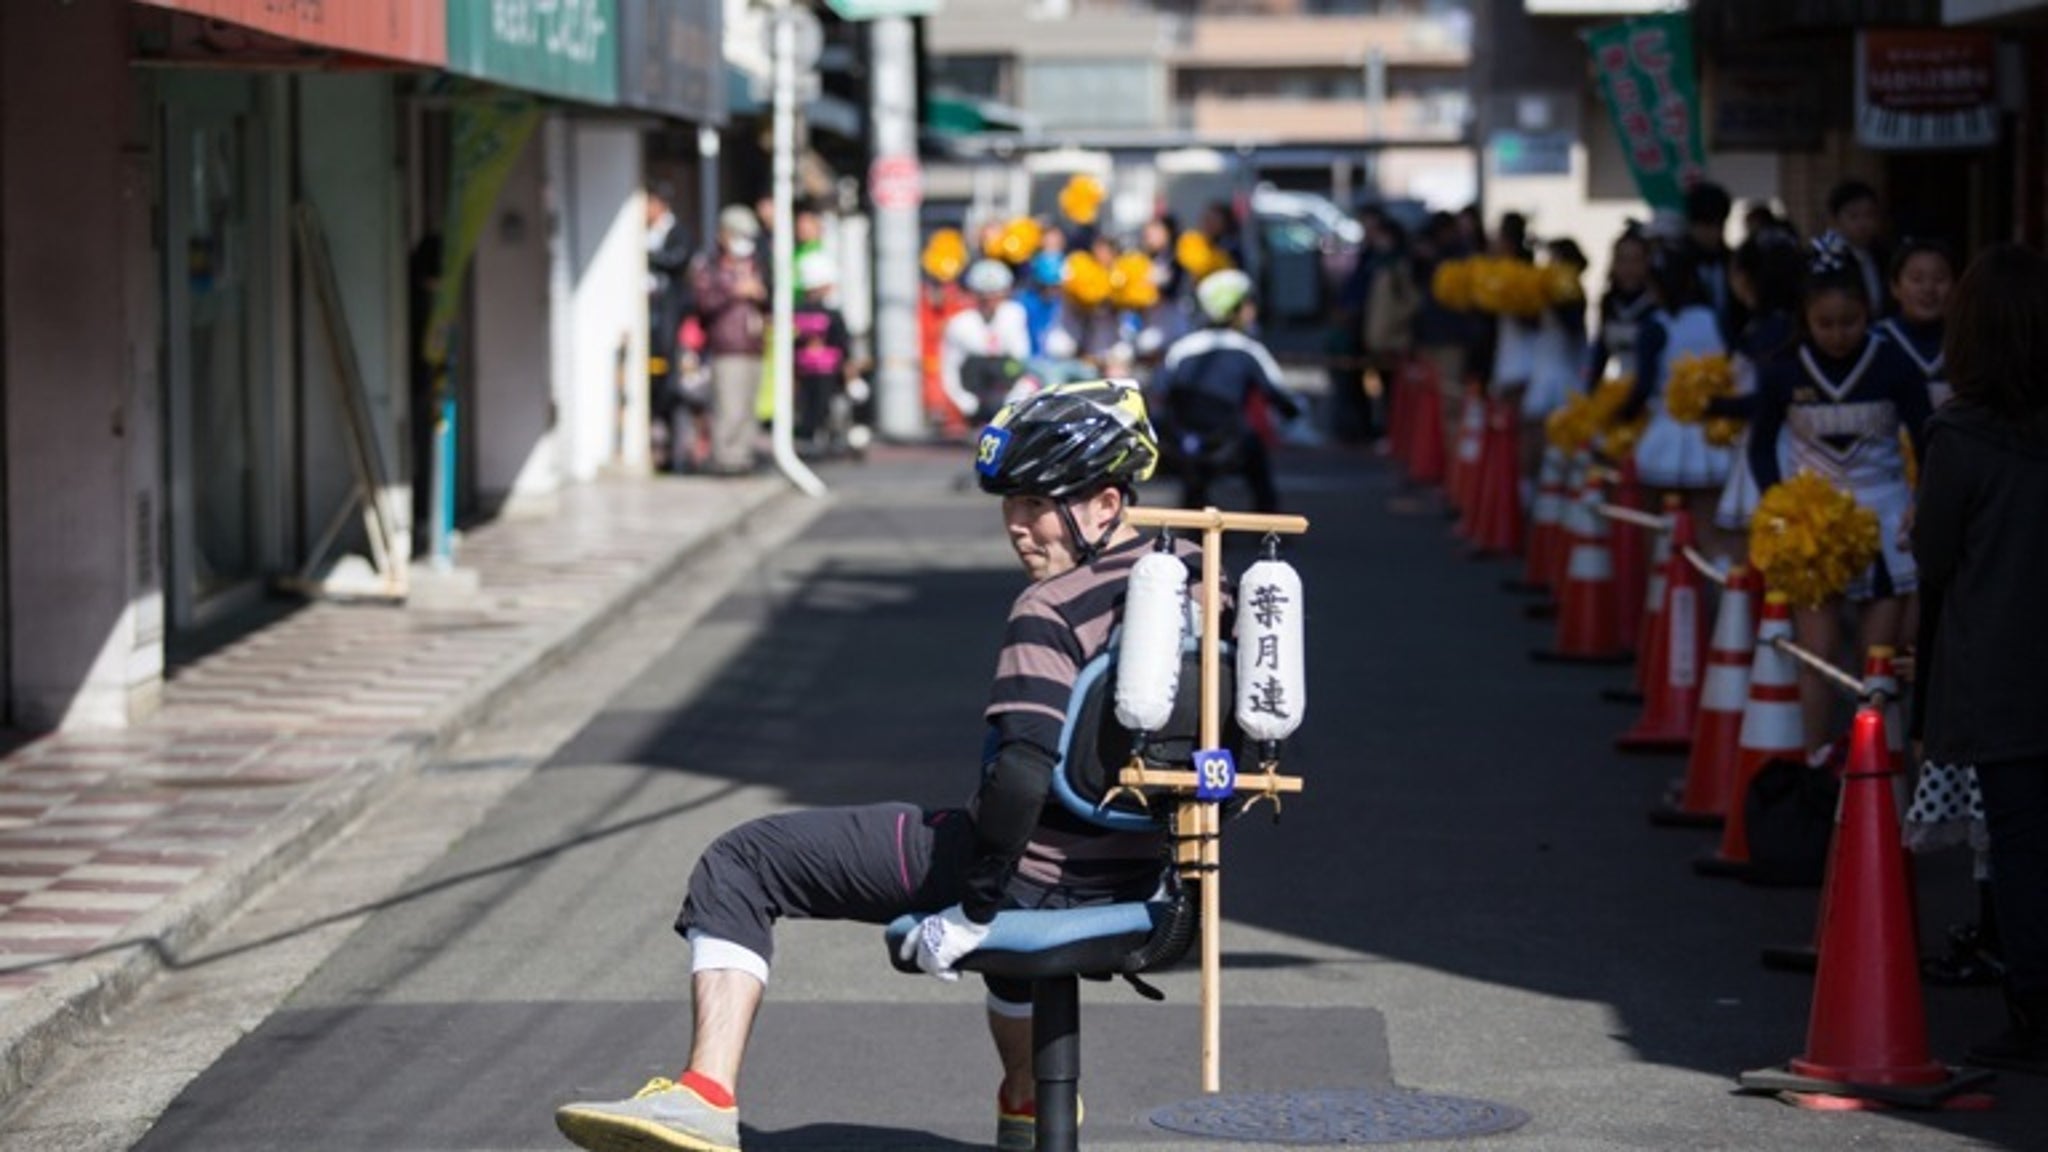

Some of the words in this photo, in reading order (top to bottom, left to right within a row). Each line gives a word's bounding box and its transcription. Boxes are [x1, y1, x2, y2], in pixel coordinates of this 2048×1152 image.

[979, 433, 1001, 465] 93
[1249, 584, 1290, 719] 葉月連
[1204, 758, 1230, 789] 93
